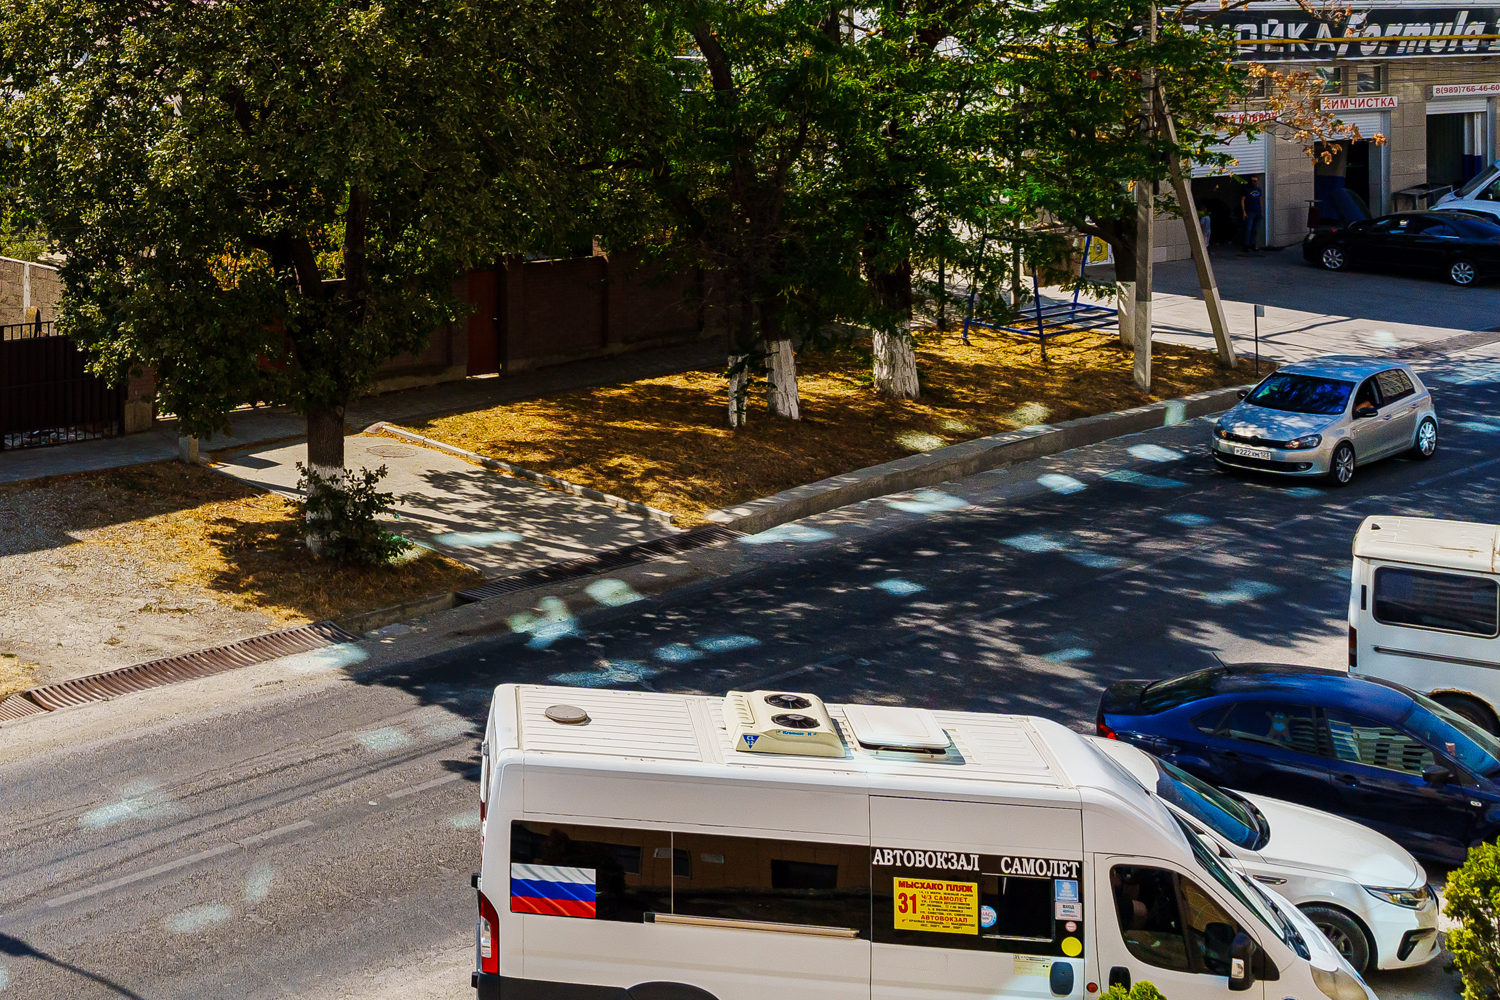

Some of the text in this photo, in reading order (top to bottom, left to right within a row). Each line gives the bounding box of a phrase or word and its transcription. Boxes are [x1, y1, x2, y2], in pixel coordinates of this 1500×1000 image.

[1336, 10, 1486, 56] Formula
[1435, 84, 1500, 95] 8(989)766-46-60
[872, 848, 1080, 878] АВТОВОКЗАЛ САМОЛЕТ
[898, 880, 973, 893] МЫСХАКО ПЛЯЖ
[898, 892, 917, 914] 31
[921, 914, 968, 923] АВТОВОКЗАЛ
